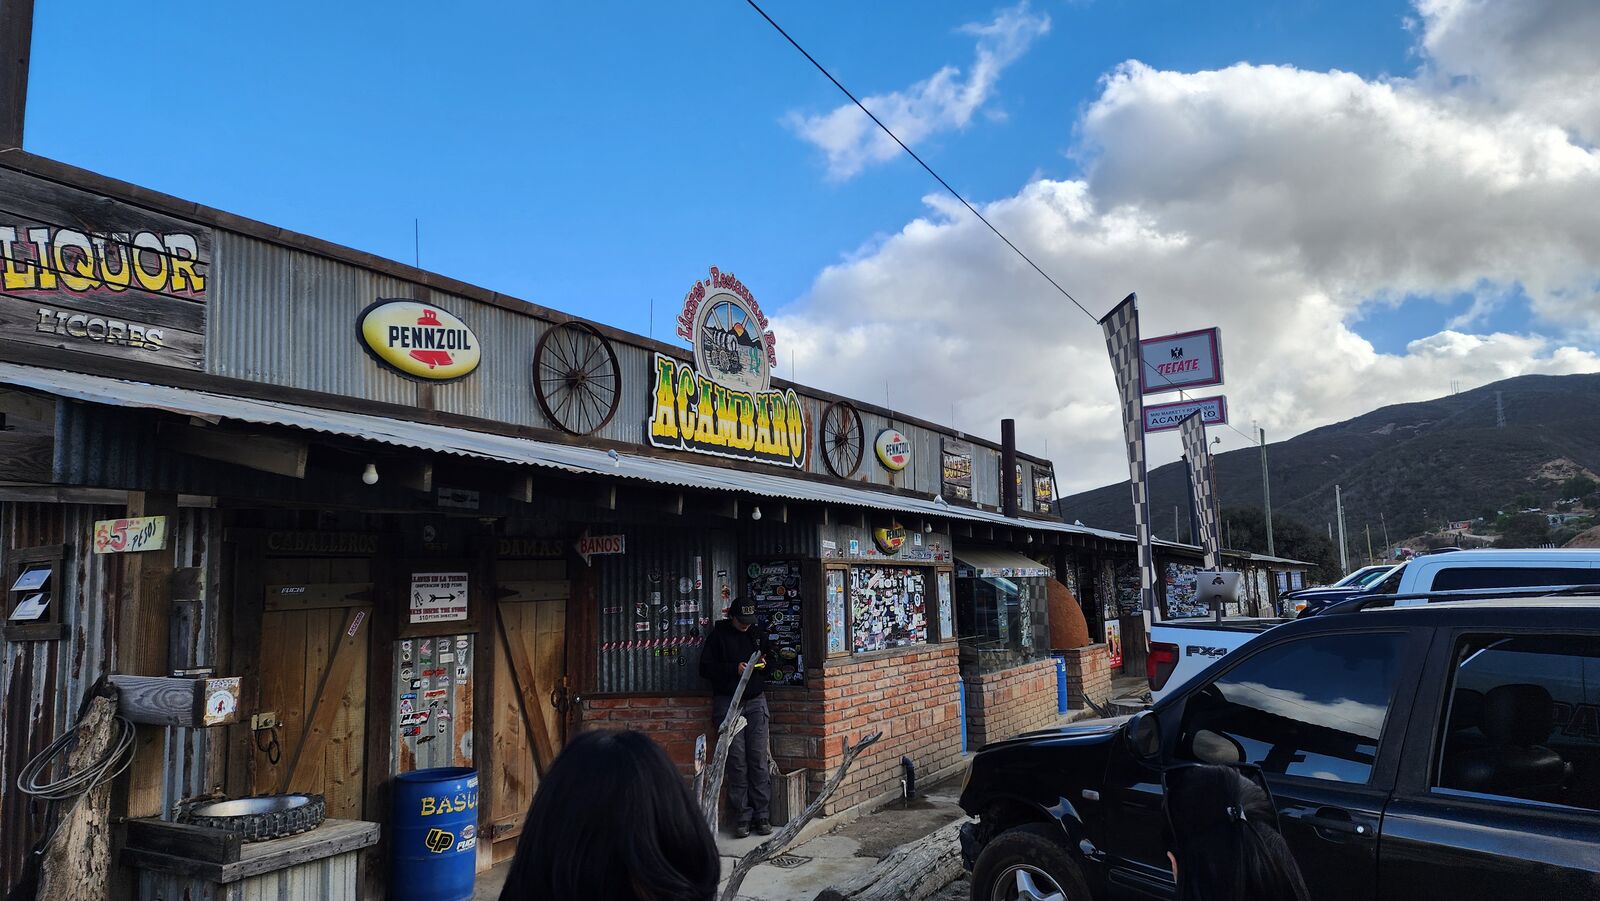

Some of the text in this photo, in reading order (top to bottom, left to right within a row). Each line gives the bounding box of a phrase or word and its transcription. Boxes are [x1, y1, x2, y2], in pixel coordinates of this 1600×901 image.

[0, 226, 206, 295] LIQUOR
[36, 308, 164, 351] LICORES
[388, 325, 471, 350] PENNZOIL
[1157, 358, 1199, 375] TECATE
[885, 441, 910, 457] PENNZOIL
[267, 532, 378, 553] CABALLEROS
[496, 538, 562, 556] DAMAS
[1186, 645, 1227, 656] FX4
[421, 791, 478, 816] BASU
